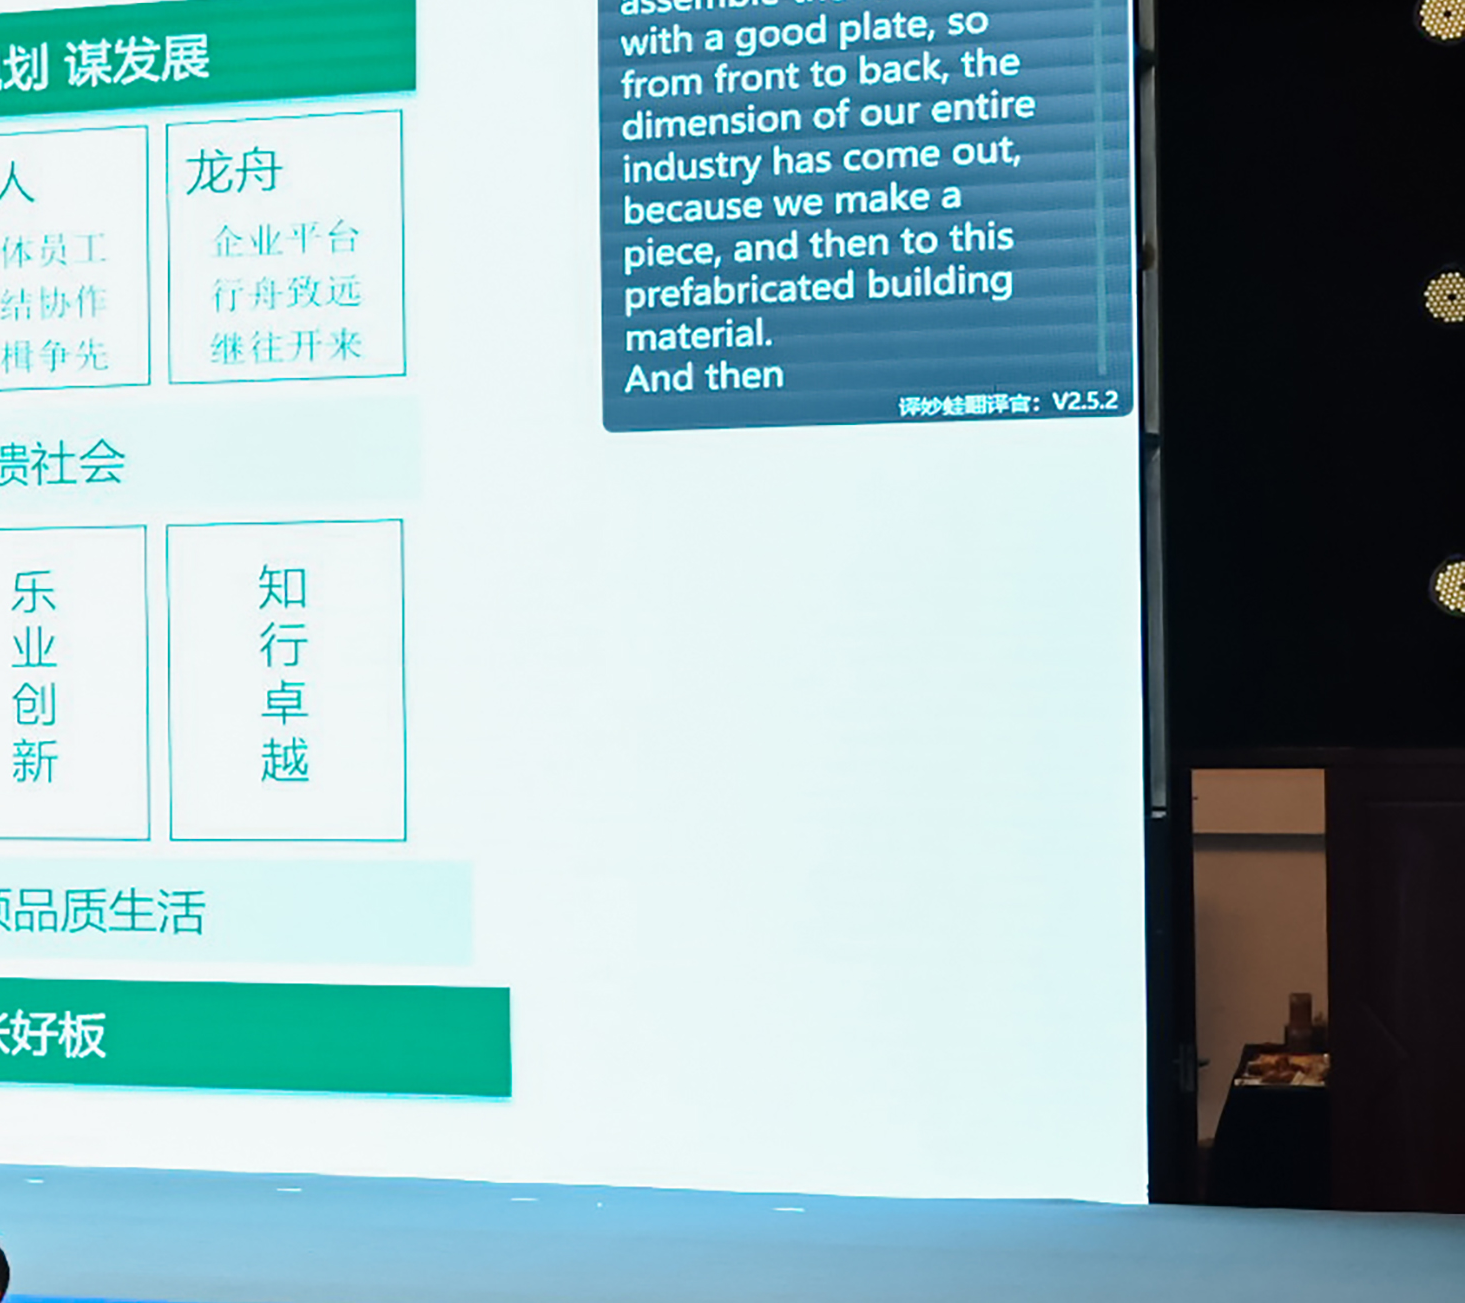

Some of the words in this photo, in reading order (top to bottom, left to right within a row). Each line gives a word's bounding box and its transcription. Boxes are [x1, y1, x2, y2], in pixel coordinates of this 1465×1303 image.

[621, 24, 693, 56] with
[704, 22, 724, 53] a
[735, 15, 828, 55] good
[839, 11, 936, 49] plate,
[949, 9, 989, 36] so
[63, 34, 211, 87] 谋发展
[621, 68, 703, 101] from
[714, 63, 801, 94] front
[810, 59, 847, 89] to
[858, 51, 951, 85] back,
[961, 48, 1021, 78] the
[623, 104, 801, 141] dimension
[813, 97, 850, 130] of
[860, 99, 921, 126] our
[931, 91, 1036, 124] entire
[186, 146, 283, 195] 龙舟
[624, 144, 762, 185] industry
[773, 144, 833, 176] has
[843, 144, 940, 172] come
[953, 135, 1021, 168] out,
[624, 191, 763, 226] because
[773, 193, 823, 217] we
[835, 182, 931, 216] make
[941, 185, 962, 209] a
[217, 219, 359, 257] 企业平台
[624, 237, 723, 275] piece,
[733, 230, 799, 263] and
[809, 226, 890, 260] then
[900, 225, 938, 255] to
[950, 221, 1015, 250] this
[215, 275, 361, 312] 行舟致远
[625, 269, 855, 316] prefabricated
[867, 265, 1015, 301] building
[211, 328, 361, 364] 继往开来
[625, 318, 773, 353] material.
[625, 364, 693, 395] And
[705, 359, 785, 392] then
[1052, 389, 1119, 411] V2.5.2
[12, 570, 58, 783] 乐业创新
[259, 565, 309, 782] 知行卓越
